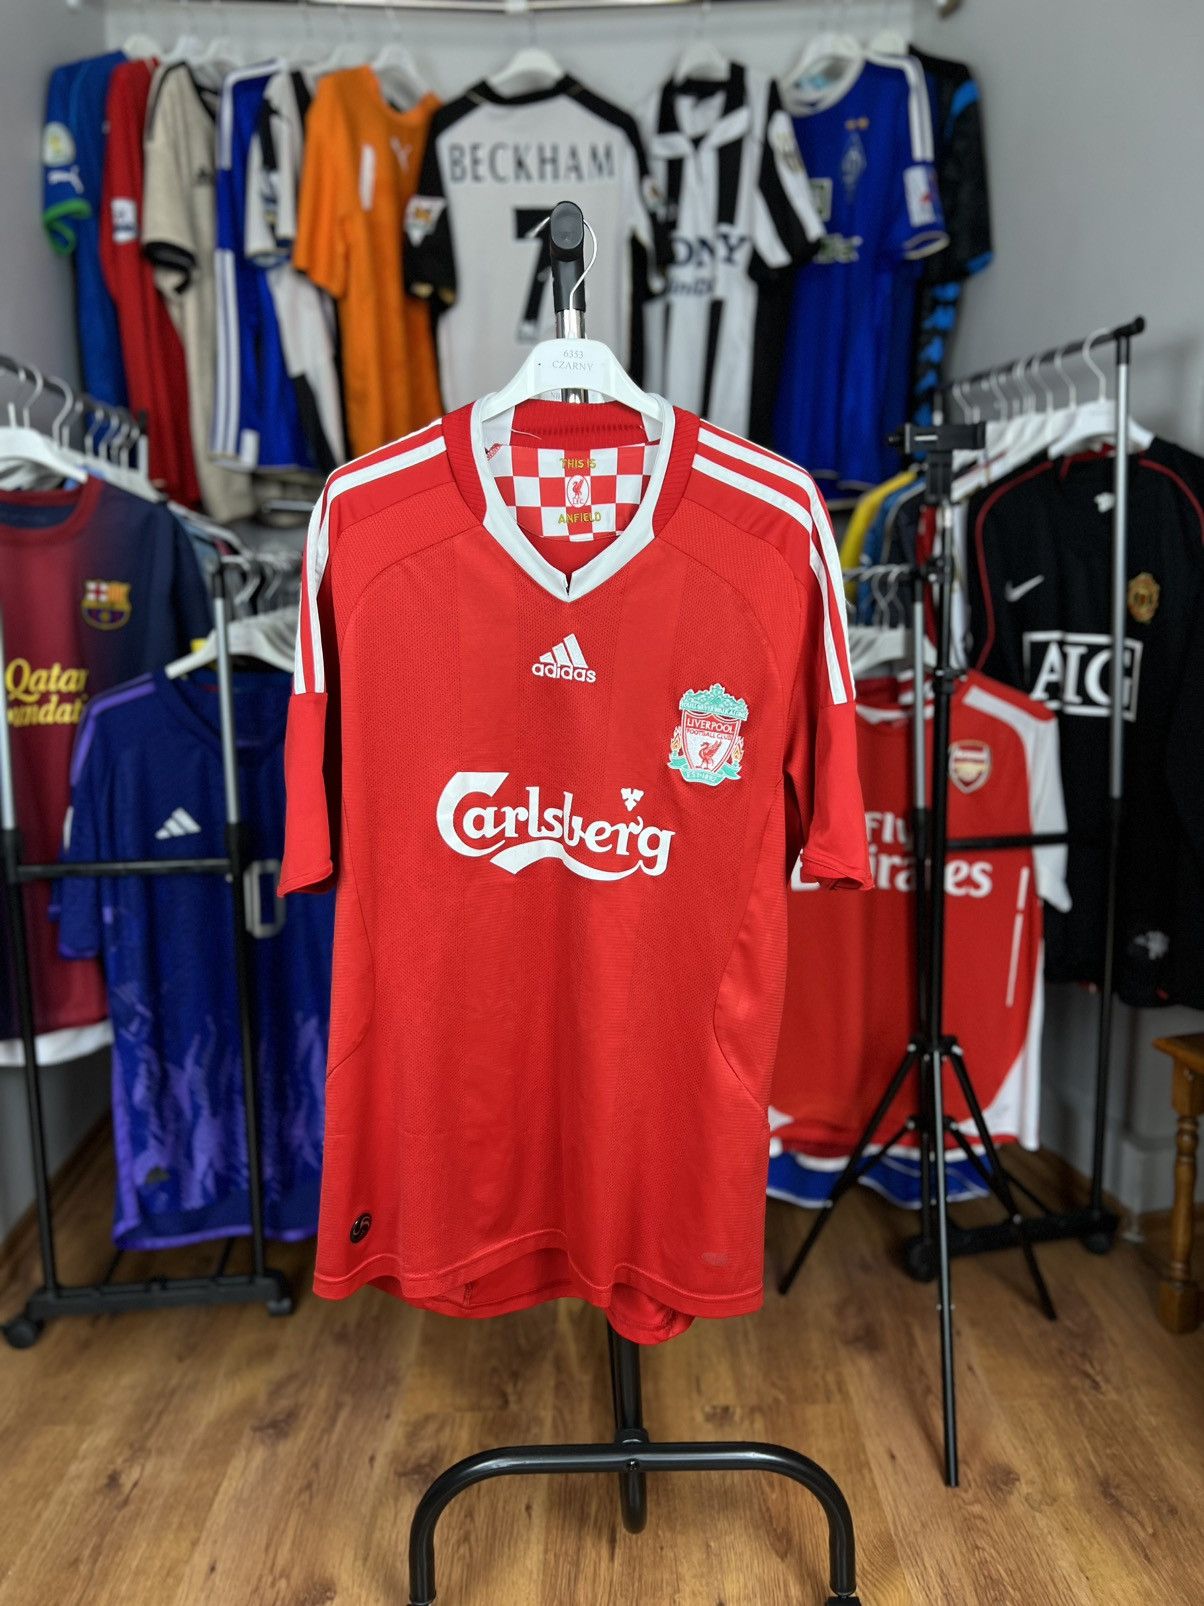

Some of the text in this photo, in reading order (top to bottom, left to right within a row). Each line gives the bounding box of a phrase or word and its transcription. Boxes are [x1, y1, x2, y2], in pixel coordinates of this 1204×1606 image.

[449, 141, 616, 183] BECKHAM
[668, 230, 748, 266] ONY
[512, 206, 555, 341] 7
[552, 360, 594, 371] CZARNY
[563, 350, 584, 359] 6353
[559, 457, 598, 469] THIS IS
[557, 511, 602, 525] ANFIELD
[531, 662, 597, 683] adidas
[1029, 640, 1133, 707] AIG
[686, 717, 735, 734] LIVERPOOL
[436, 771, 677, 881] Carlsberg
[241, 859, 287, 939] 0
